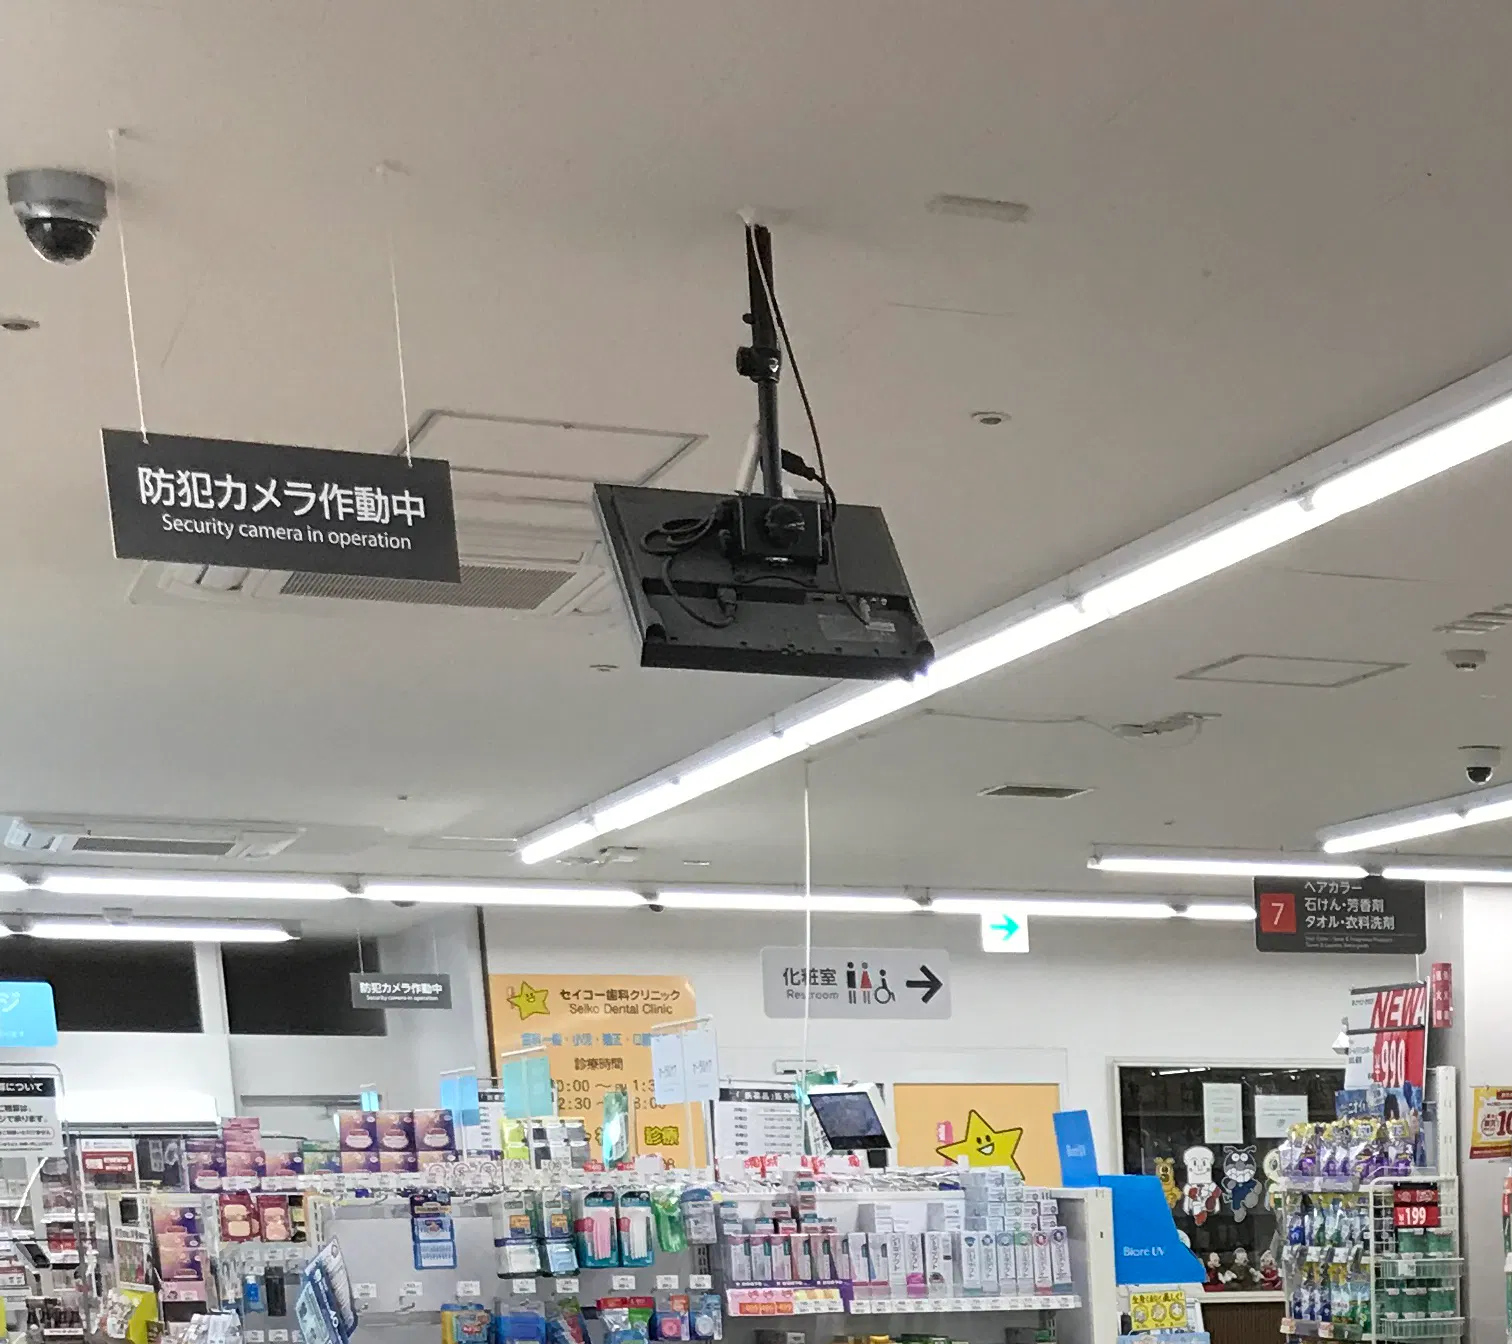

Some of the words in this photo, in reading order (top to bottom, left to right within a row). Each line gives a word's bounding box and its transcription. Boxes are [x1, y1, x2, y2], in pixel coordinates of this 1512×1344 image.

[137, 466, 426, 528] 防犯カメラ作動中
[162, 513, 234, 540] Security
[239, 523, 303, 542] camera
[307, 525, 323, 542] in
[328, 530, 412, 550] operation
[1304, 881, 1363, 894] ヘアカラー
[1304, 897, 1385, 912] 石けん・芳香剤
[1271, 902, 1285, 925] 7
[1305, 915, 1396, 930] タオル・衣料洗剤
[782, 967, 838, 988] 化粧室
[359, 981, 444, 996] 防犯カメラ作動中
[560, 988, 681, 1002] セイコー歯科クリニック
[603, 1003, 641, 1015] Dental
[642, 1003, 673, 1015] Clinic
